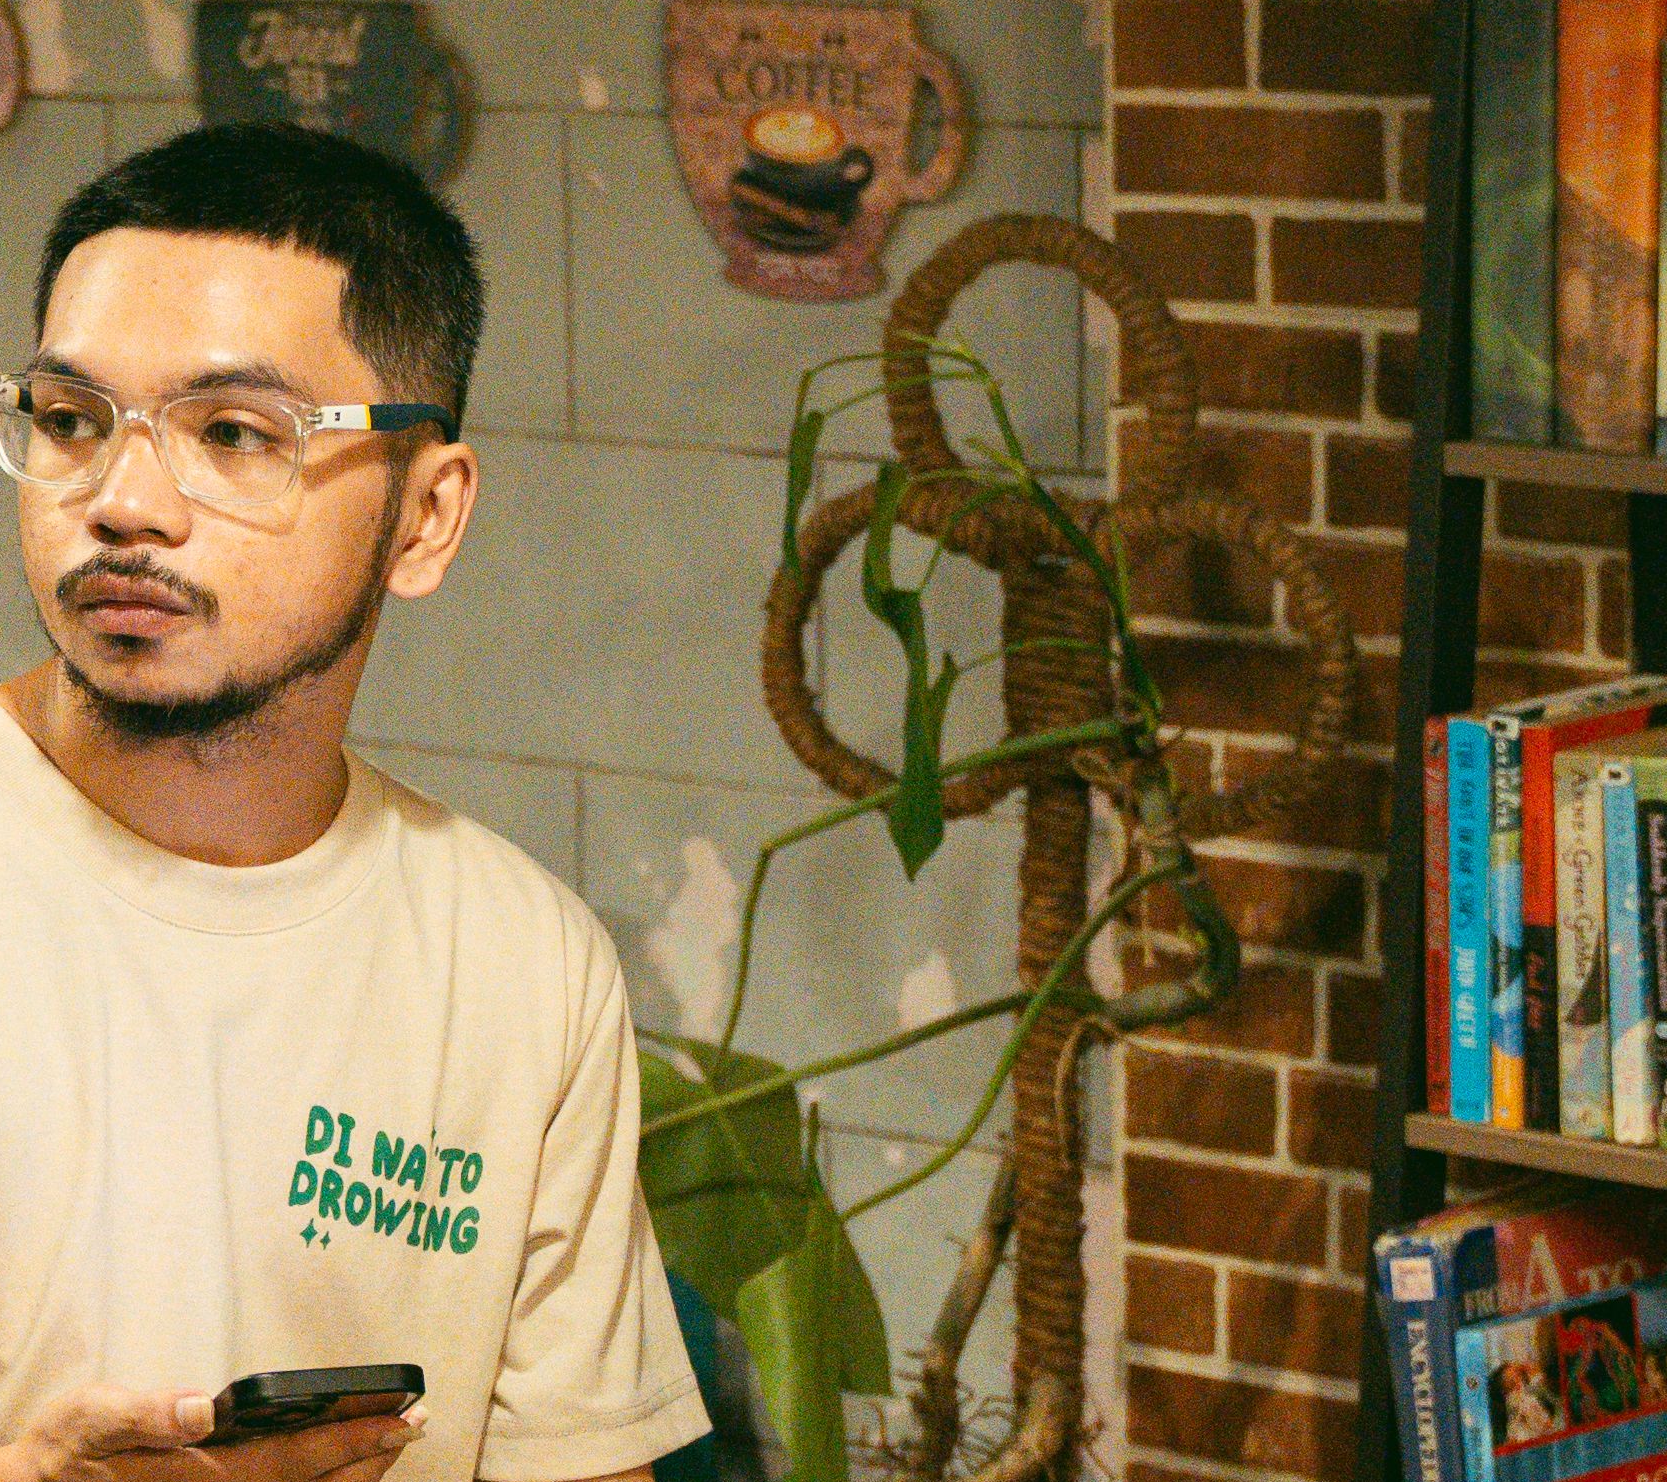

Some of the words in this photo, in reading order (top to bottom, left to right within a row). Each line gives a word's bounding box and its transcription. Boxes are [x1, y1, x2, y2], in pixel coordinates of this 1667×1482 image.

[714, 64, 871, 108] COFFEE
[305, 1105, 356, 1169] DI
[372, 1130, 428, 1192] NA
[288, 1160, 482, 1255] DROWING
[1523, 1231, 1567, 1309] A
[1576, 1257, 1644, 1294] TO
